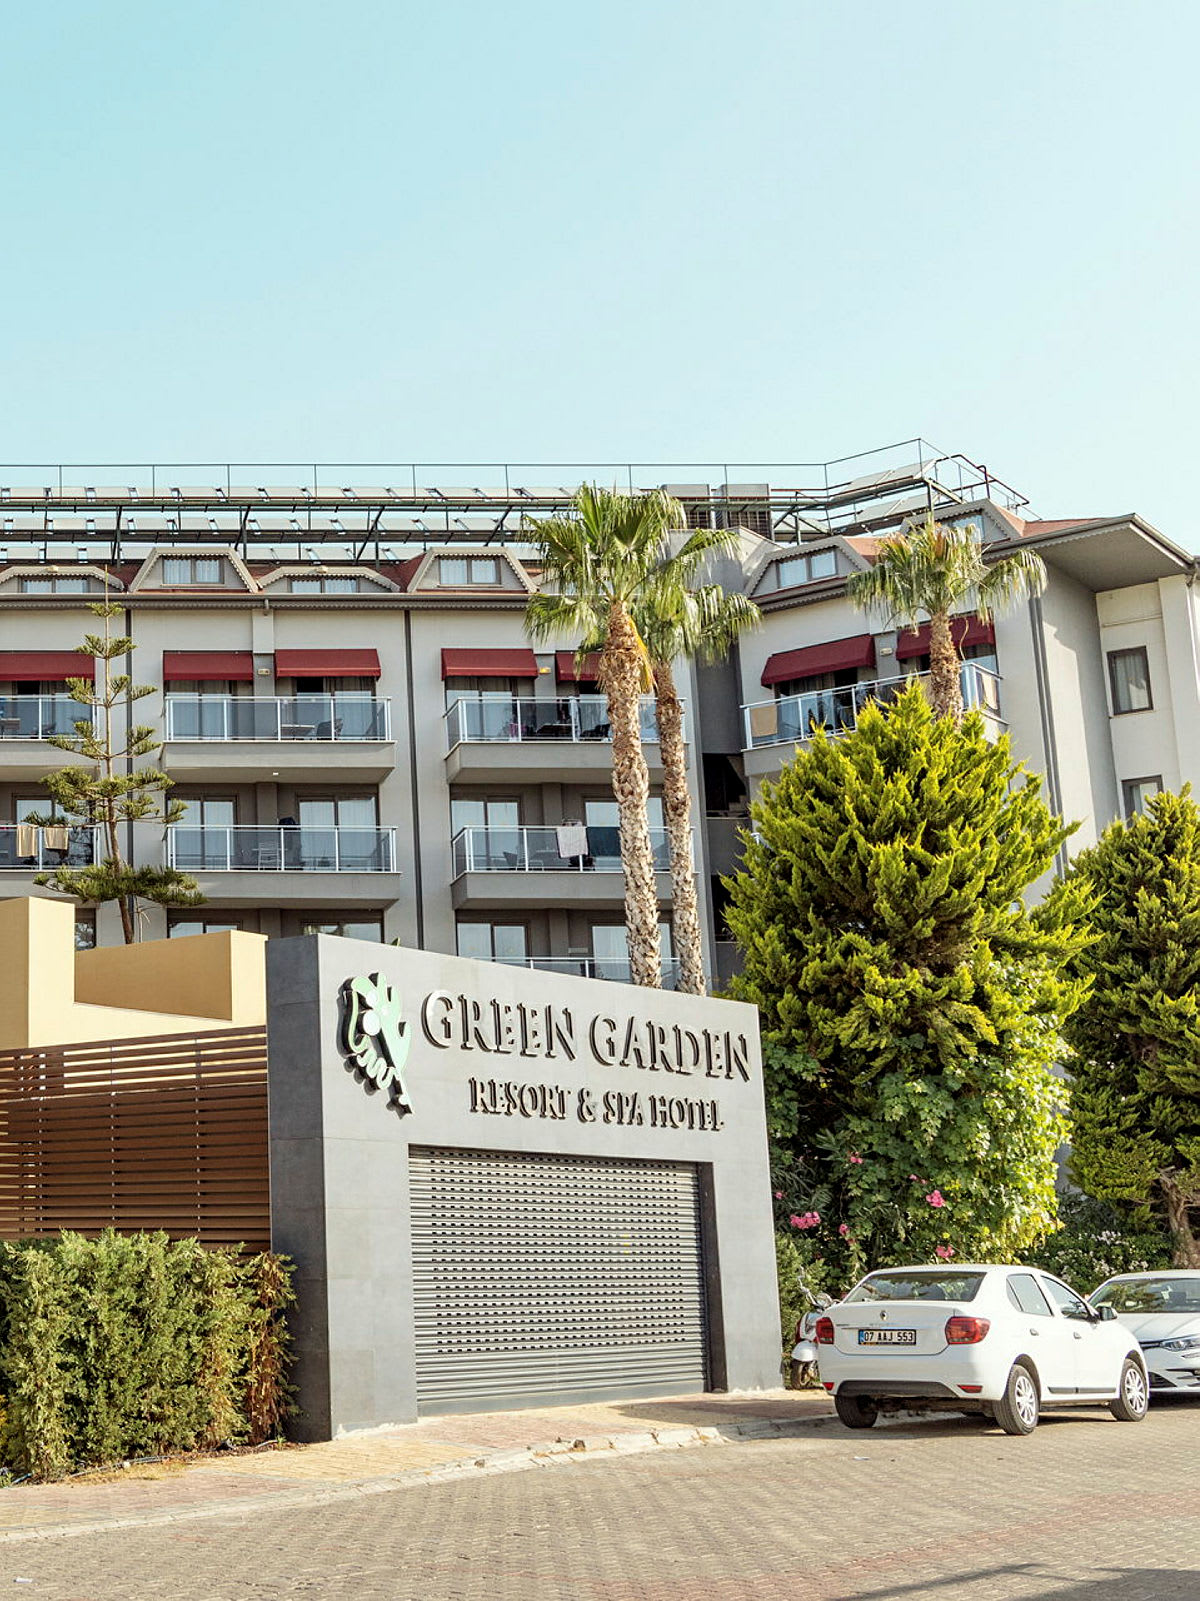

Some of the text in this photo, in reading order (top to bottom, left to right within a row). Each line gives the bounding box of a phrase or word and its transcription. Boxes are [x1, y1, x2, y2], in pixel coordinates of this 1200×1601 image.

[420, 990, 750, 1083] GREEN GARDEN
[468, 1077, 724, 1132] RESORT & SPA HOTEL
[864, 1331, 874, 1342] 07
[897, 1332, 913, 1342] 553
